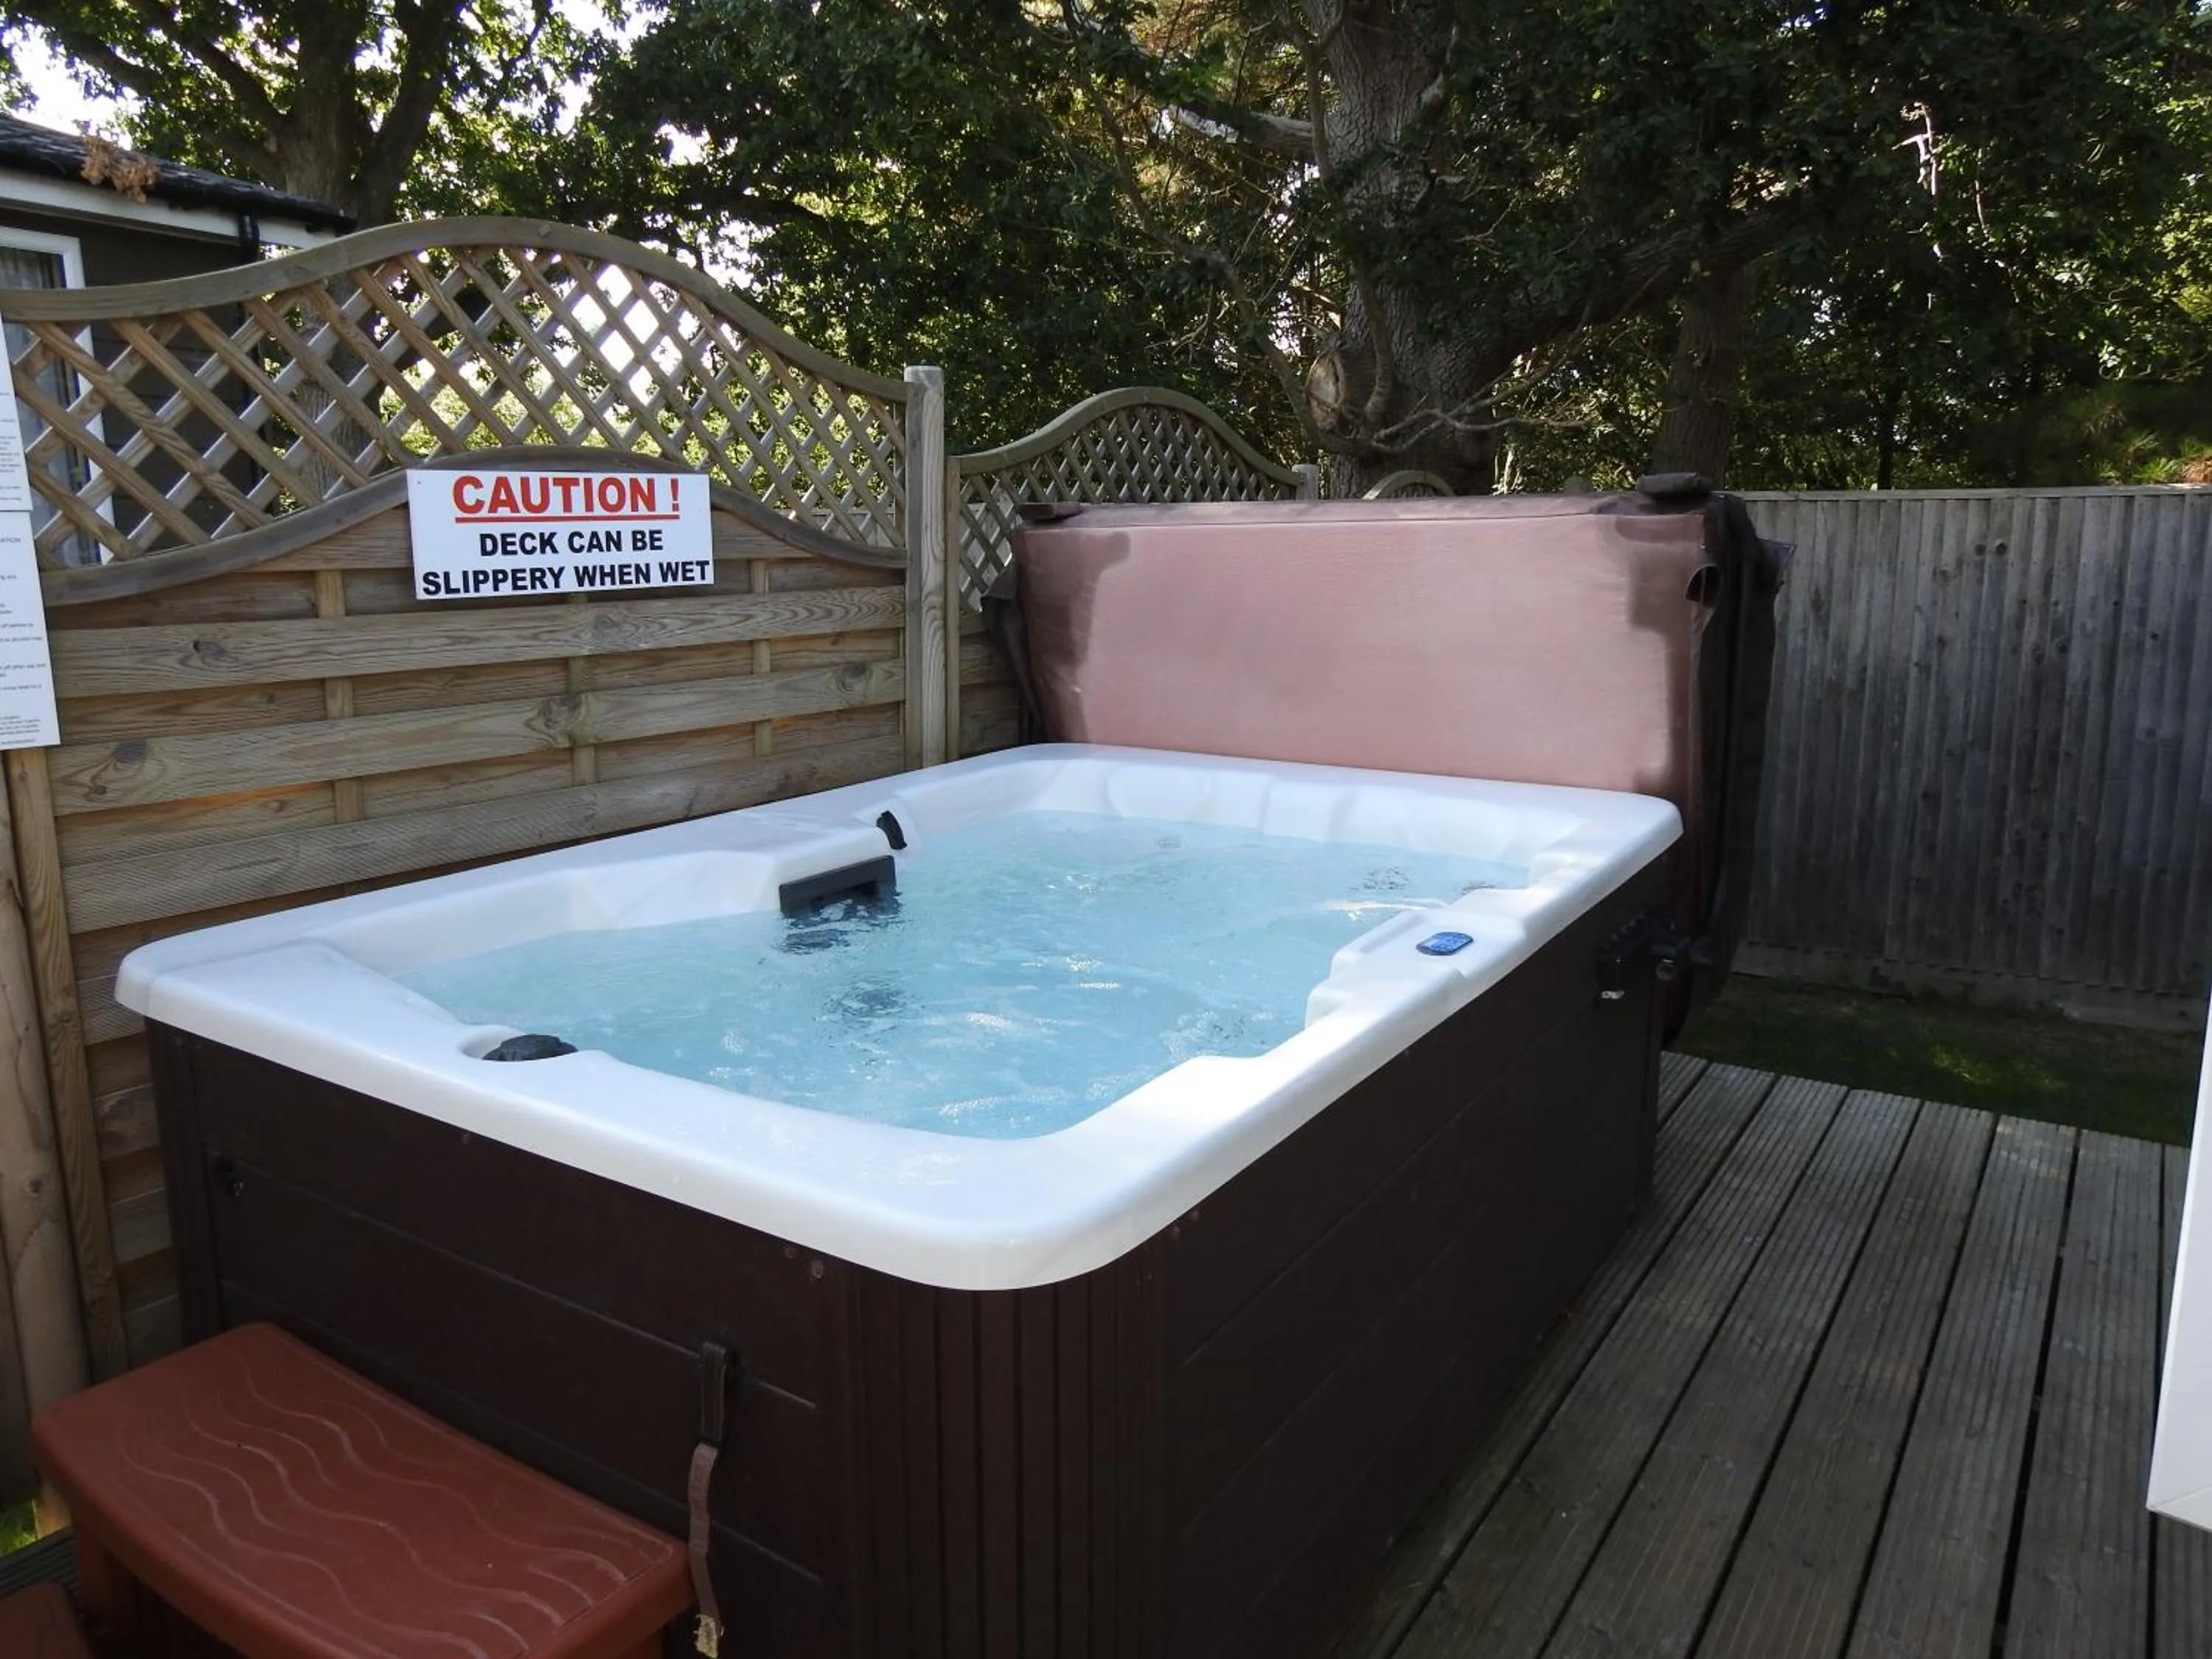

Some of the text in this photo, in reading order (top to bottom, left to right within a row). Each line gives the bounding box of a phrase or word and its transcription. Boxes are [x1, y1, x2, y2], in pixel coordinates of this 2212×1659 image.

[453, 476, 680, 514] CAUTION !
[479, 529, 664, 557] DECK CAN BE
[422, 560, 711, 596] SLIPPERY WHEN WET
